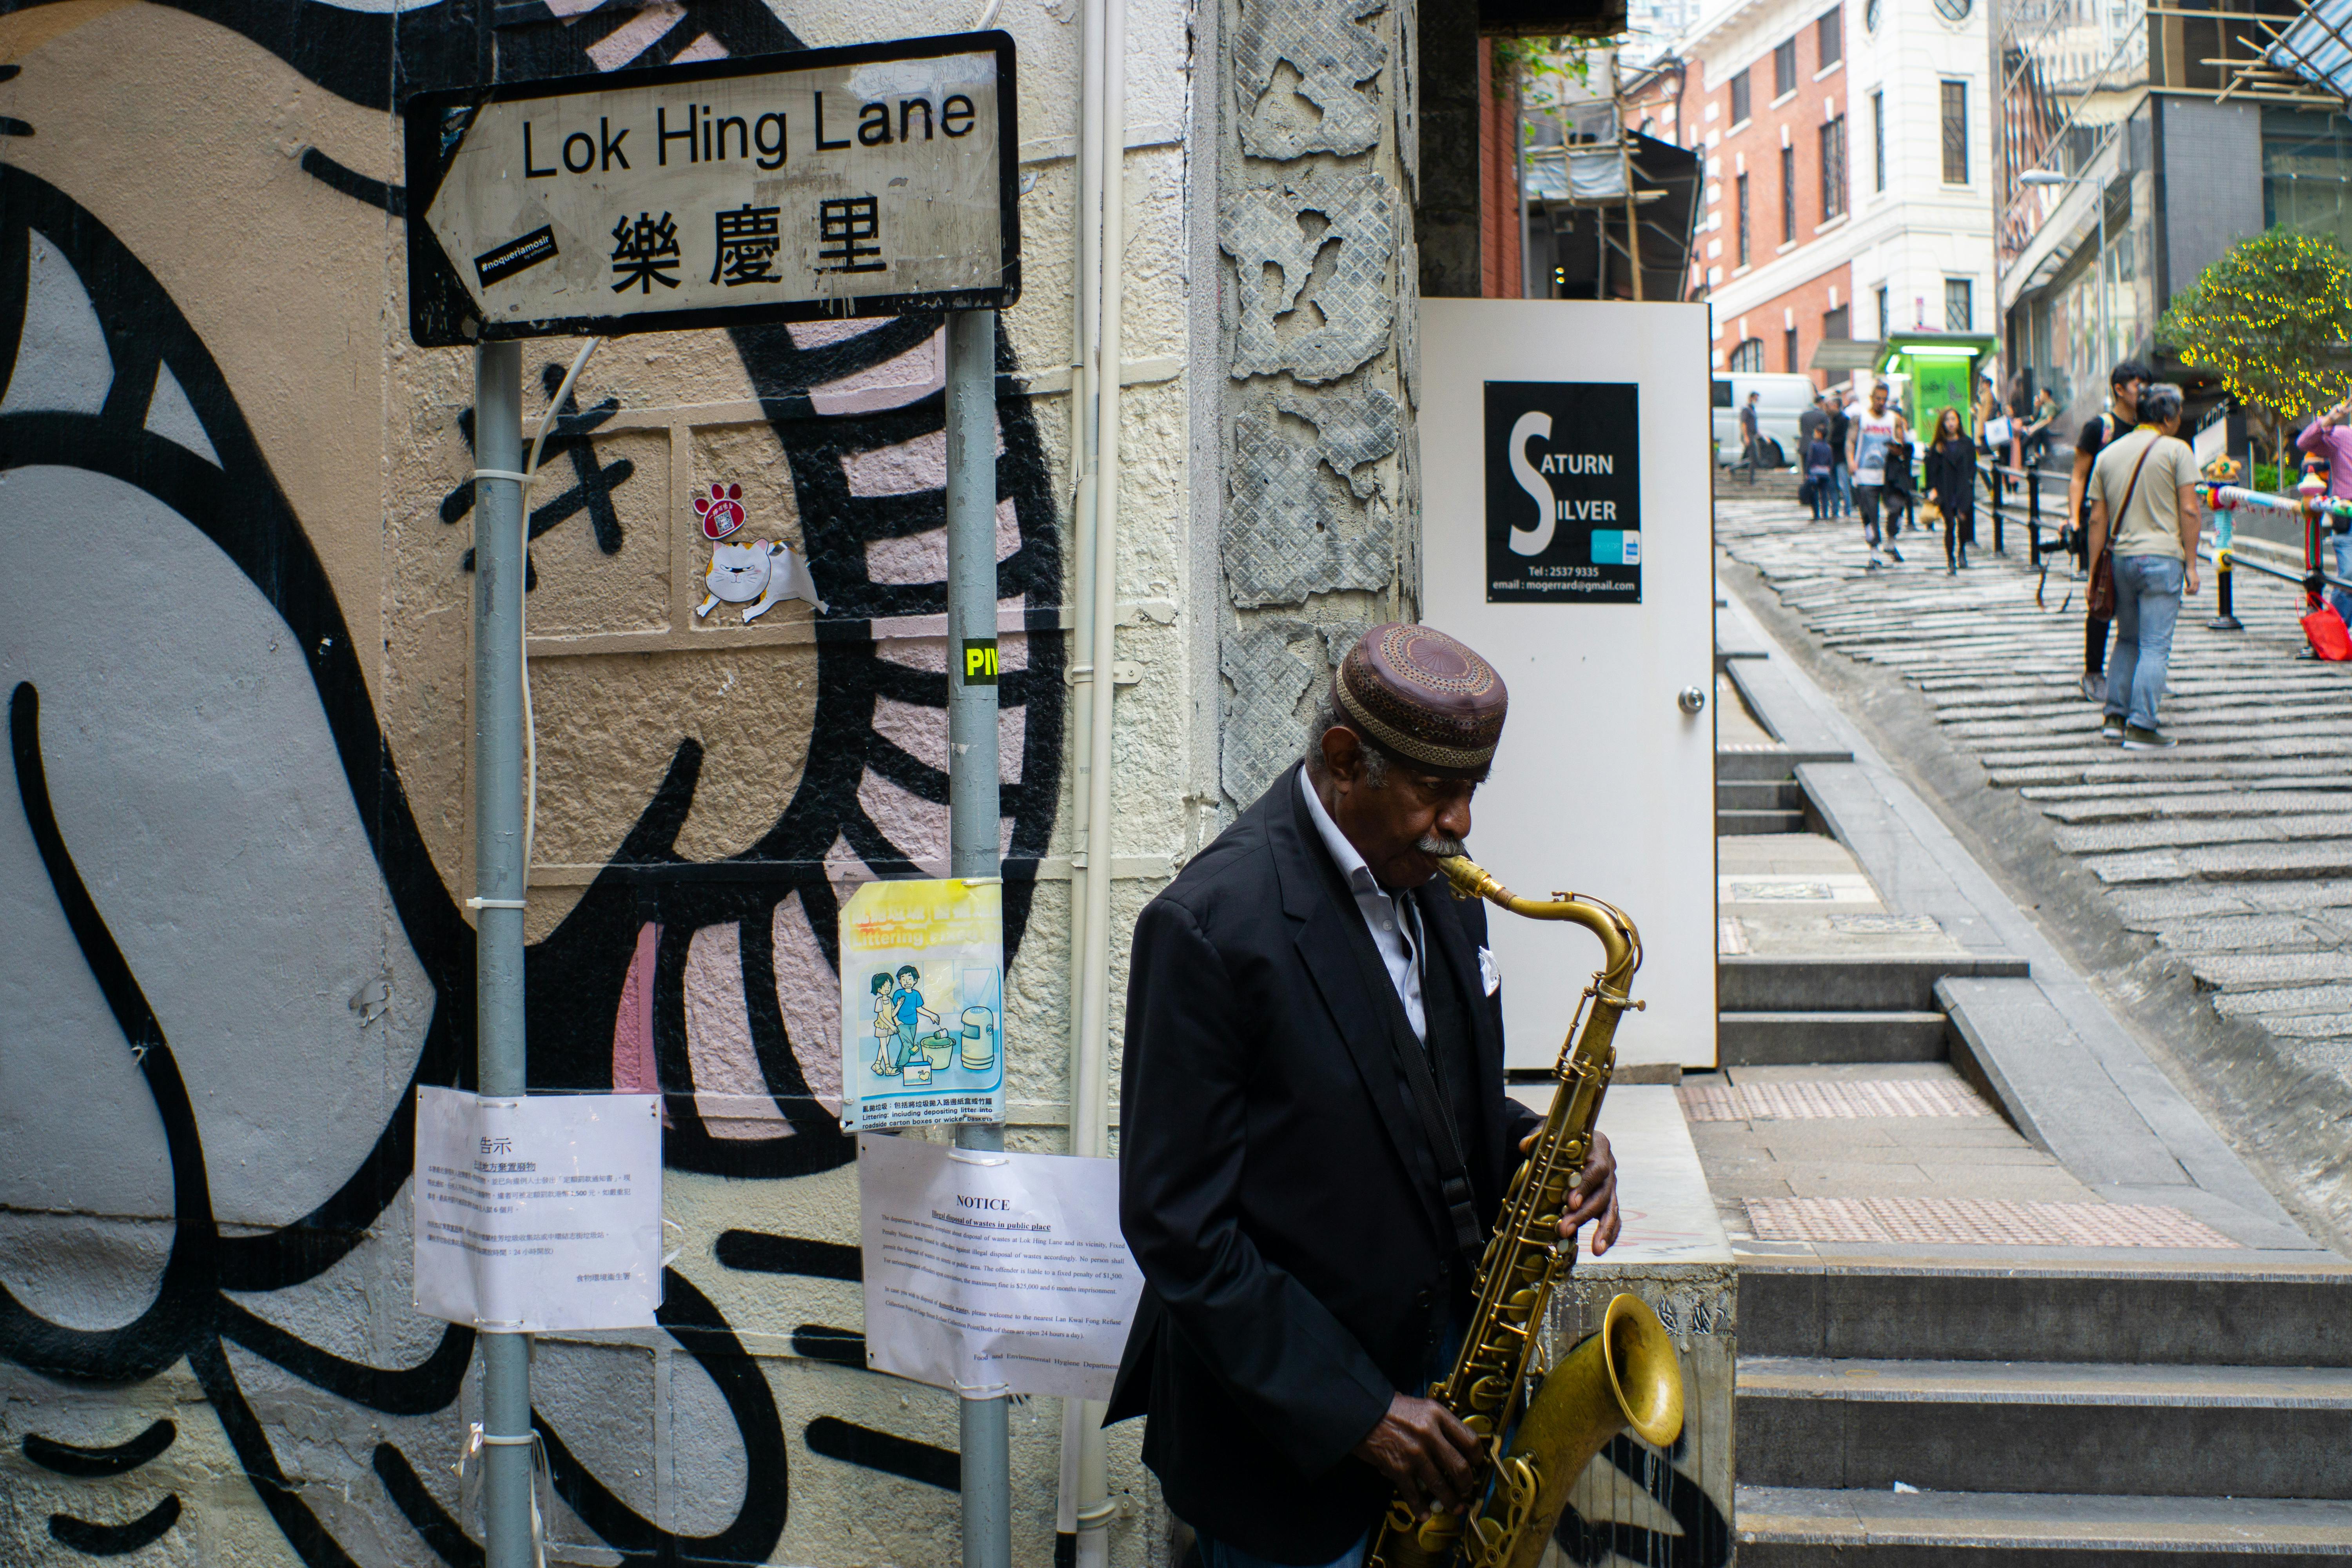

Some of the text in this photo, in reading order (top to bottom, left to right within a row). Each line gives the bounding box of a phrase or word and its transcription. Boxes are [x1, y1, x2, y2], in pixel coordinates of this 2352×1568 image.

[523, 91, 975, 179] Lok Hing Lane
[610, 196, 887, 294] 樂慶里
[1550, 567, 1574, 577] 2537
[1575, 566, 1599, 577] 9335
[1526, 580, 1635, 592] mogerrard@gmail.com
[924, 1108, 958, 1116] depositing
[481, 1137, 512, 1154] 告示
[957, 1195, 1010, 1210] NOTICE
[891, 1216, 912, 1224] department
[932, 1210, 945, 1219] Illegal
[946, 1214, 964, 1224] disposal
[948, 1318, 966, 1328] Collection
[1007, 1353, 1051, 1363] Environmental
[1083, 1361, 1119, 1369] Department
